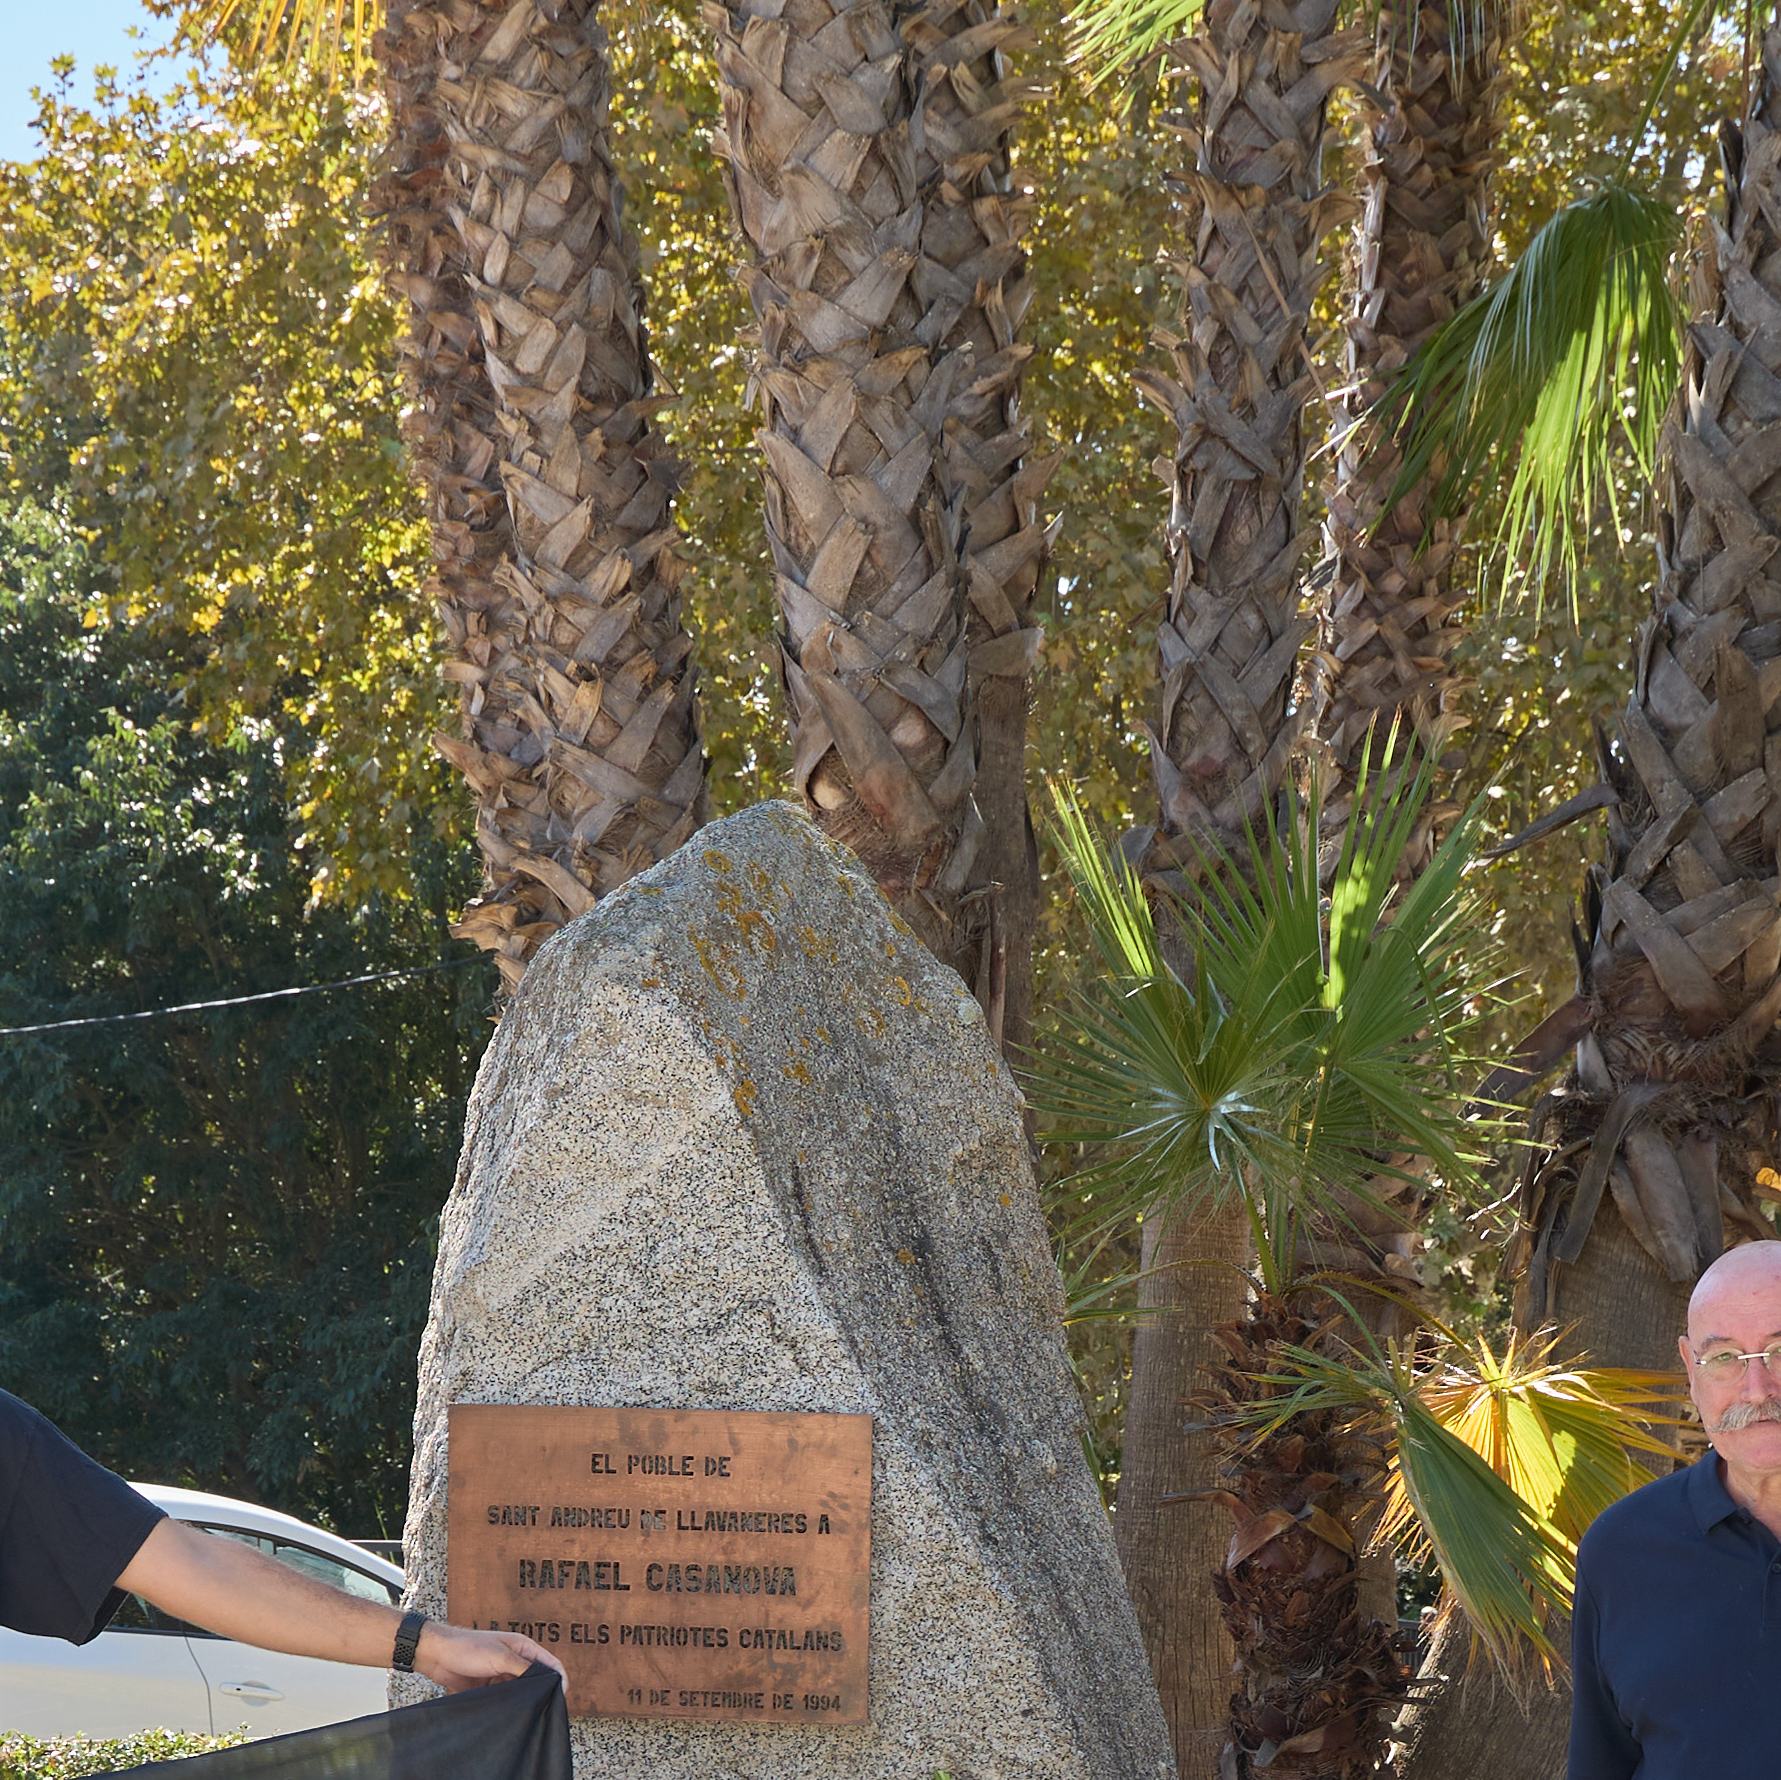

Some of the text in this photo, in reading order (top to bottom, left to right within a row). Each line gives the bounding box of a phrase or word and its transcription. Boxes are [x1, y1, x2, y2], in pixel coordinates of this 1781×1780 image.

[590, 1453, 731, 1478] EL POBLE DE
[487, 1504, 831, 1535] SANT ANDREU DE LLAVANERES A
[519, 1558, 797, 1596] RAFAEL CASANOVA
[570, 1623, 610, 1644] ELS
[620, 1624, 729, 1648] PATRIOTES
[738, 1628, 843, 1652] CATALANS
[627, 1688, 842, 1712] 11 DE SETEMBRE DE 1994
